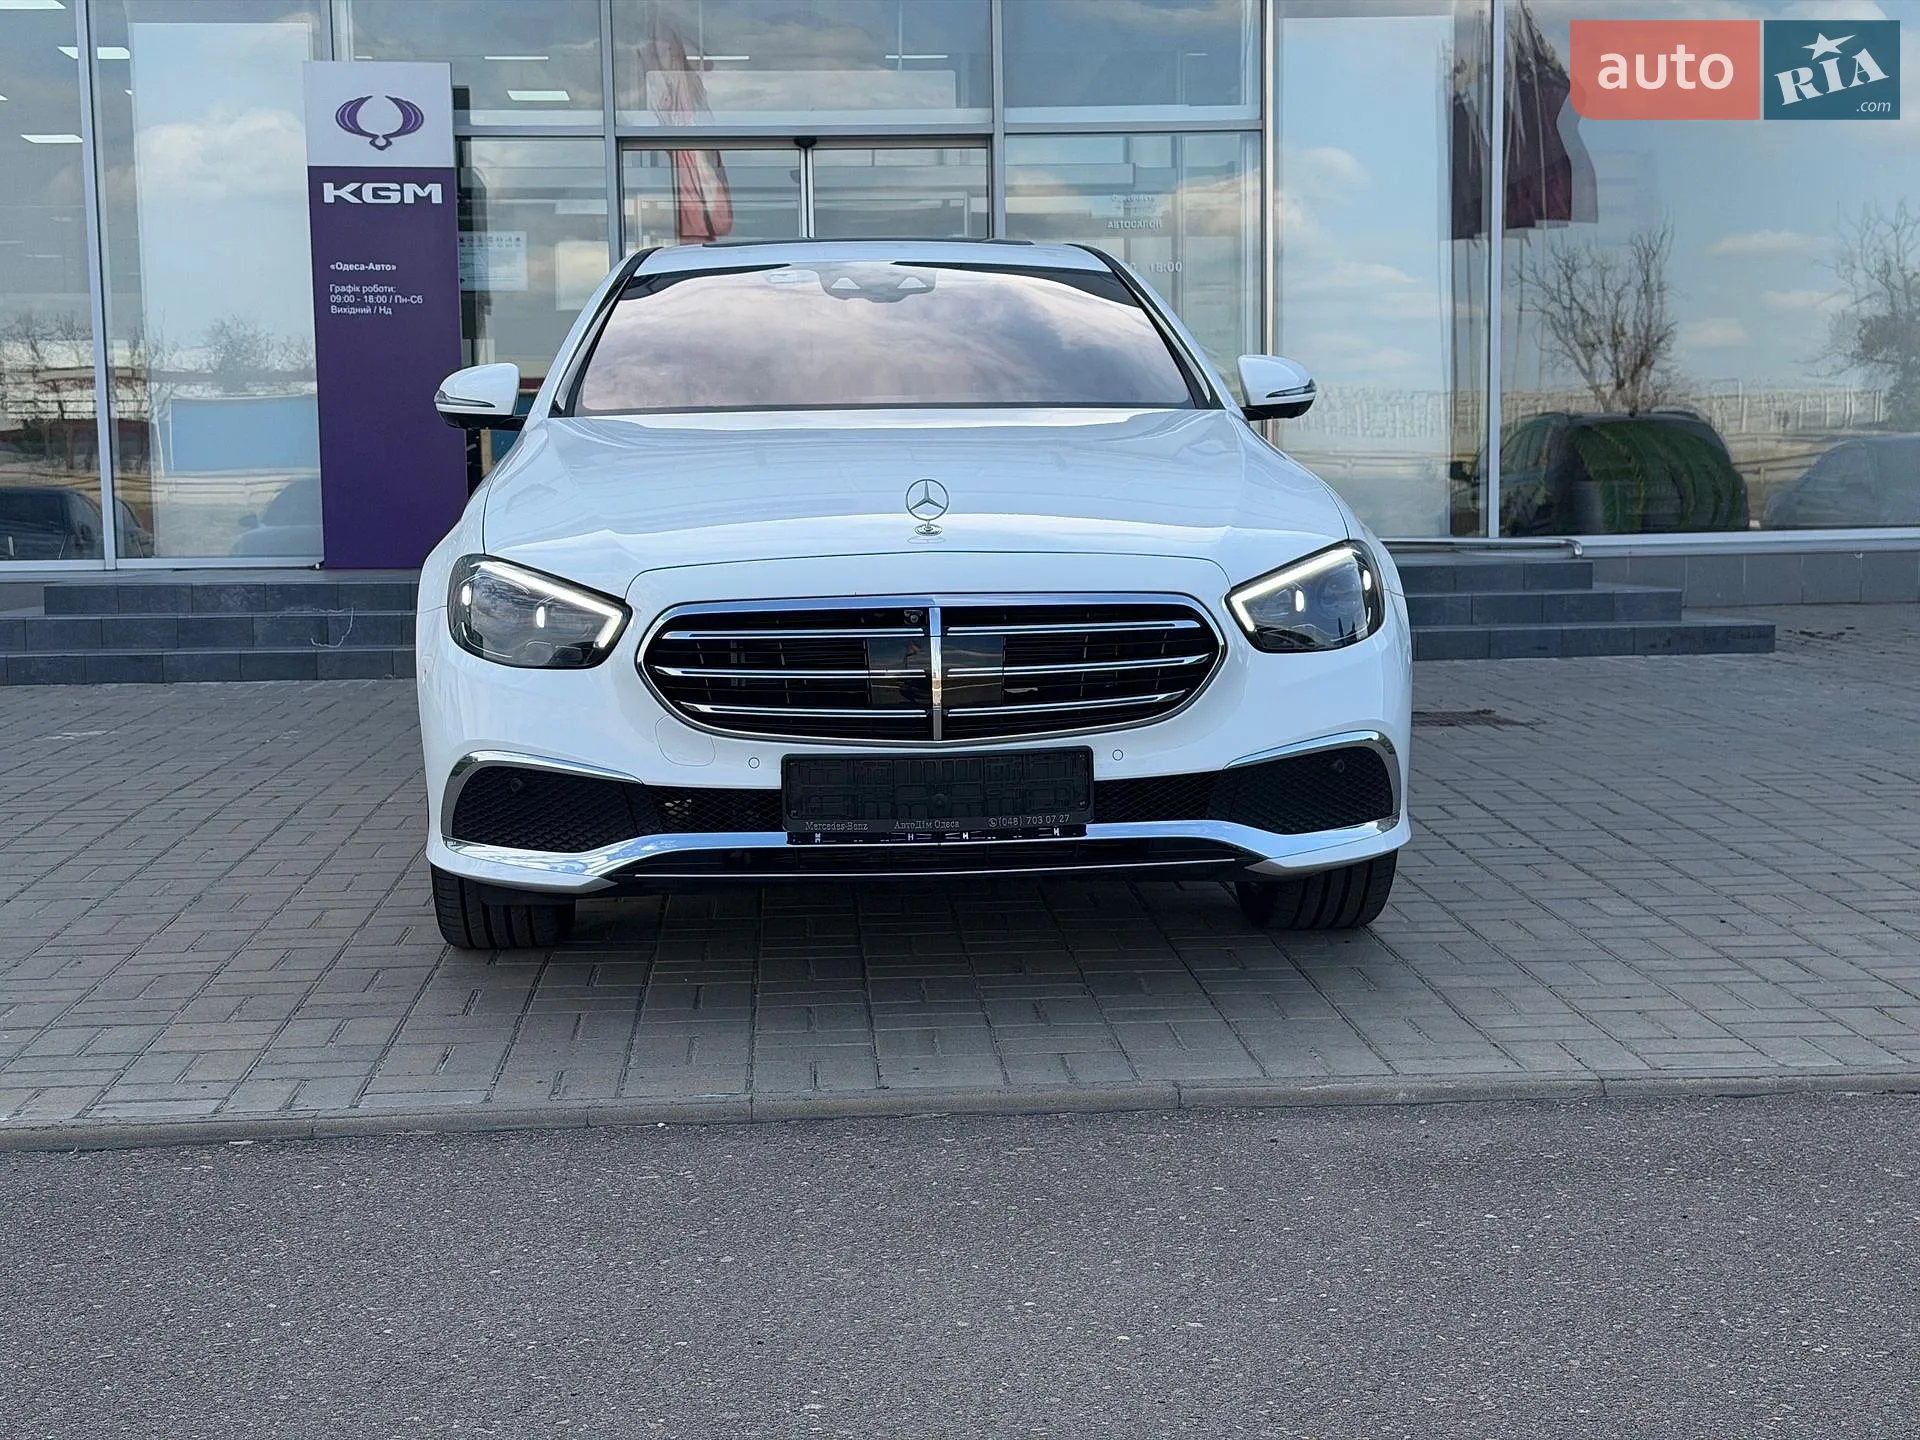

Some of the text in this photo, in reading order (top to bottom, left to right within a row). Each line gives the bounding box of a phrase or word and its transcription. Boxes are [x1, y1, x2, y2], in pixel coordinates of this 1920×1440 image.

[323, 182, 443, 204] KGM
[329, 261, 397, 271] «Одеса-Авто»
[329, 283, 397, 294] Графік роботи:
[330, 294, 355, 303] 09:00
[363, 294, 388, 304] 18:00
[394, 295, 424, 304] Пн-Сб
[330, 304, 372, 315] Вихідний
[378, 305, 393, 315] Нд
[805, 821, 869, 831] Mercedes-Benz
[894, 819, 960, 830] АвтоДім Одеса
[998, 814, 1070, 827] (048) 703 07 27
